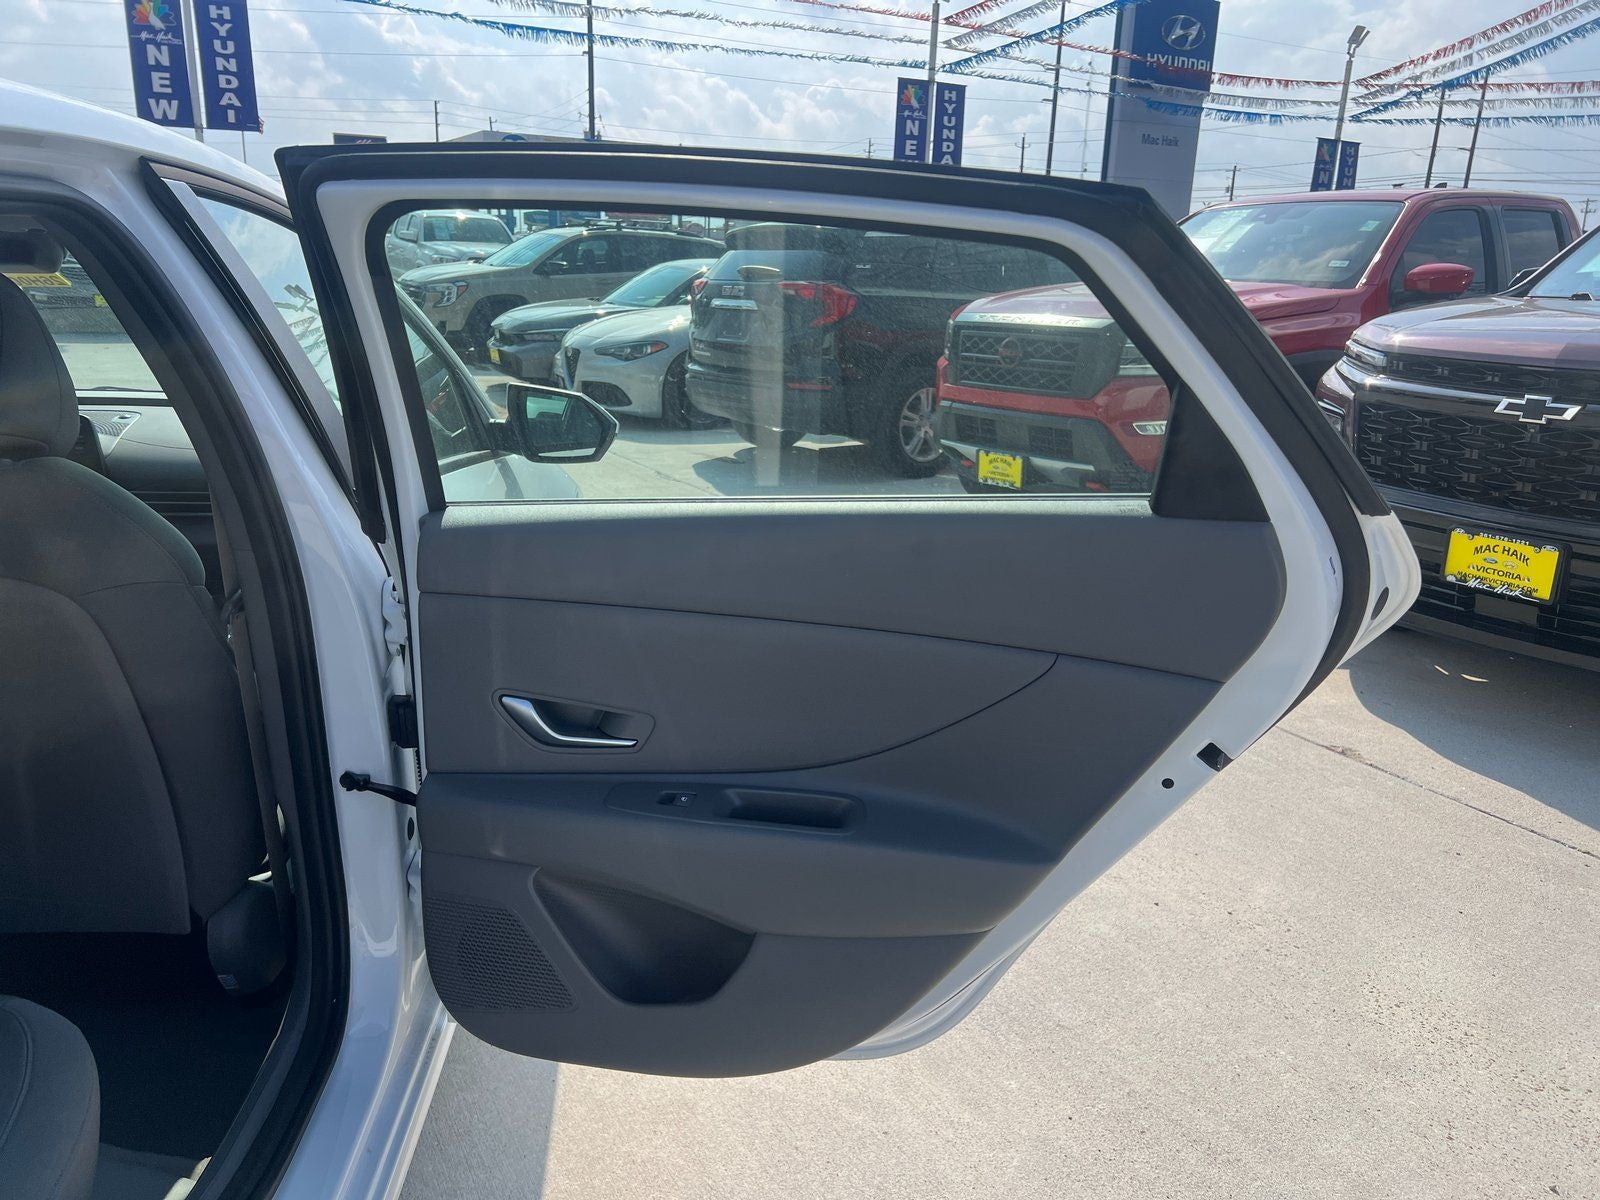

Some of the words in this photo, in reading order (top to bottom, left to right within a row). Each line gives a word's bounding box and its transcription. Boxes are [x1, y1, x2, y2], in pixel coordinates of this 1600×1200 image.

[208, 4, 242, 124] HYUNDAI
[146, 43, 179, 121] NEW
[902, 119, 920, 163] NE
[1141, 132, 1160, 146] Mac
[1161, 134, 1180, 148] Haik
[1473, 544, 1500, 556] MAC
[1501, 545, 1531, 567] HAIK
[1475, 565, 1522, 582] VICTORIA
[1465, 577, 1494, 592] Mac
[1494, 584, 1526, 598] Haik
